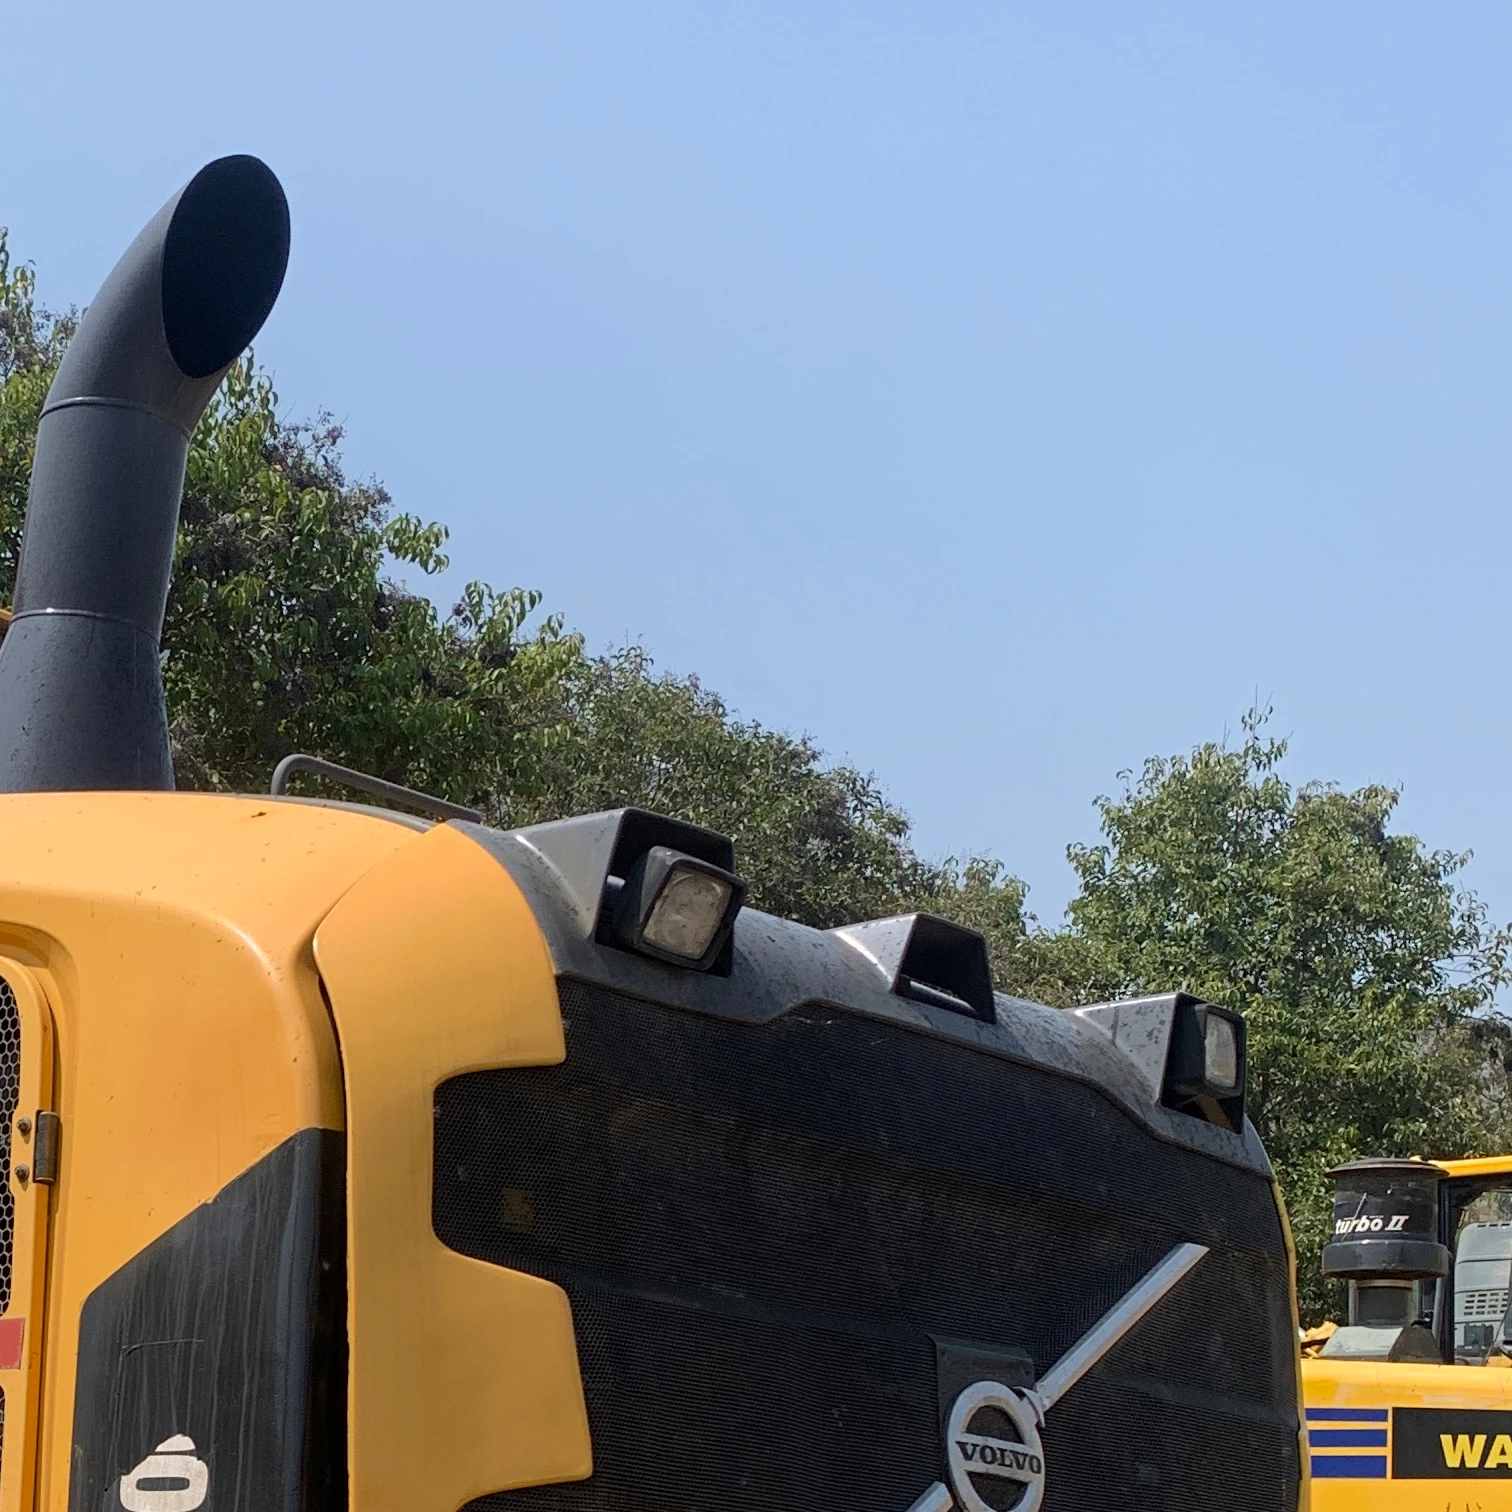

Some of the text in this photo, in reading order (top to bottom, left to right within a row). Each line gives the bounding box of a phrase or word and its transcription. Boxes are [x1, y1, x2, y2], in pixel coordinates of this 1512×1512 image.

[1335, 1214, 1384, 1235] turbo
[955, 1440, 1042, 1475] VOLVO
[1440, 1433, 1512, 1469] WA
